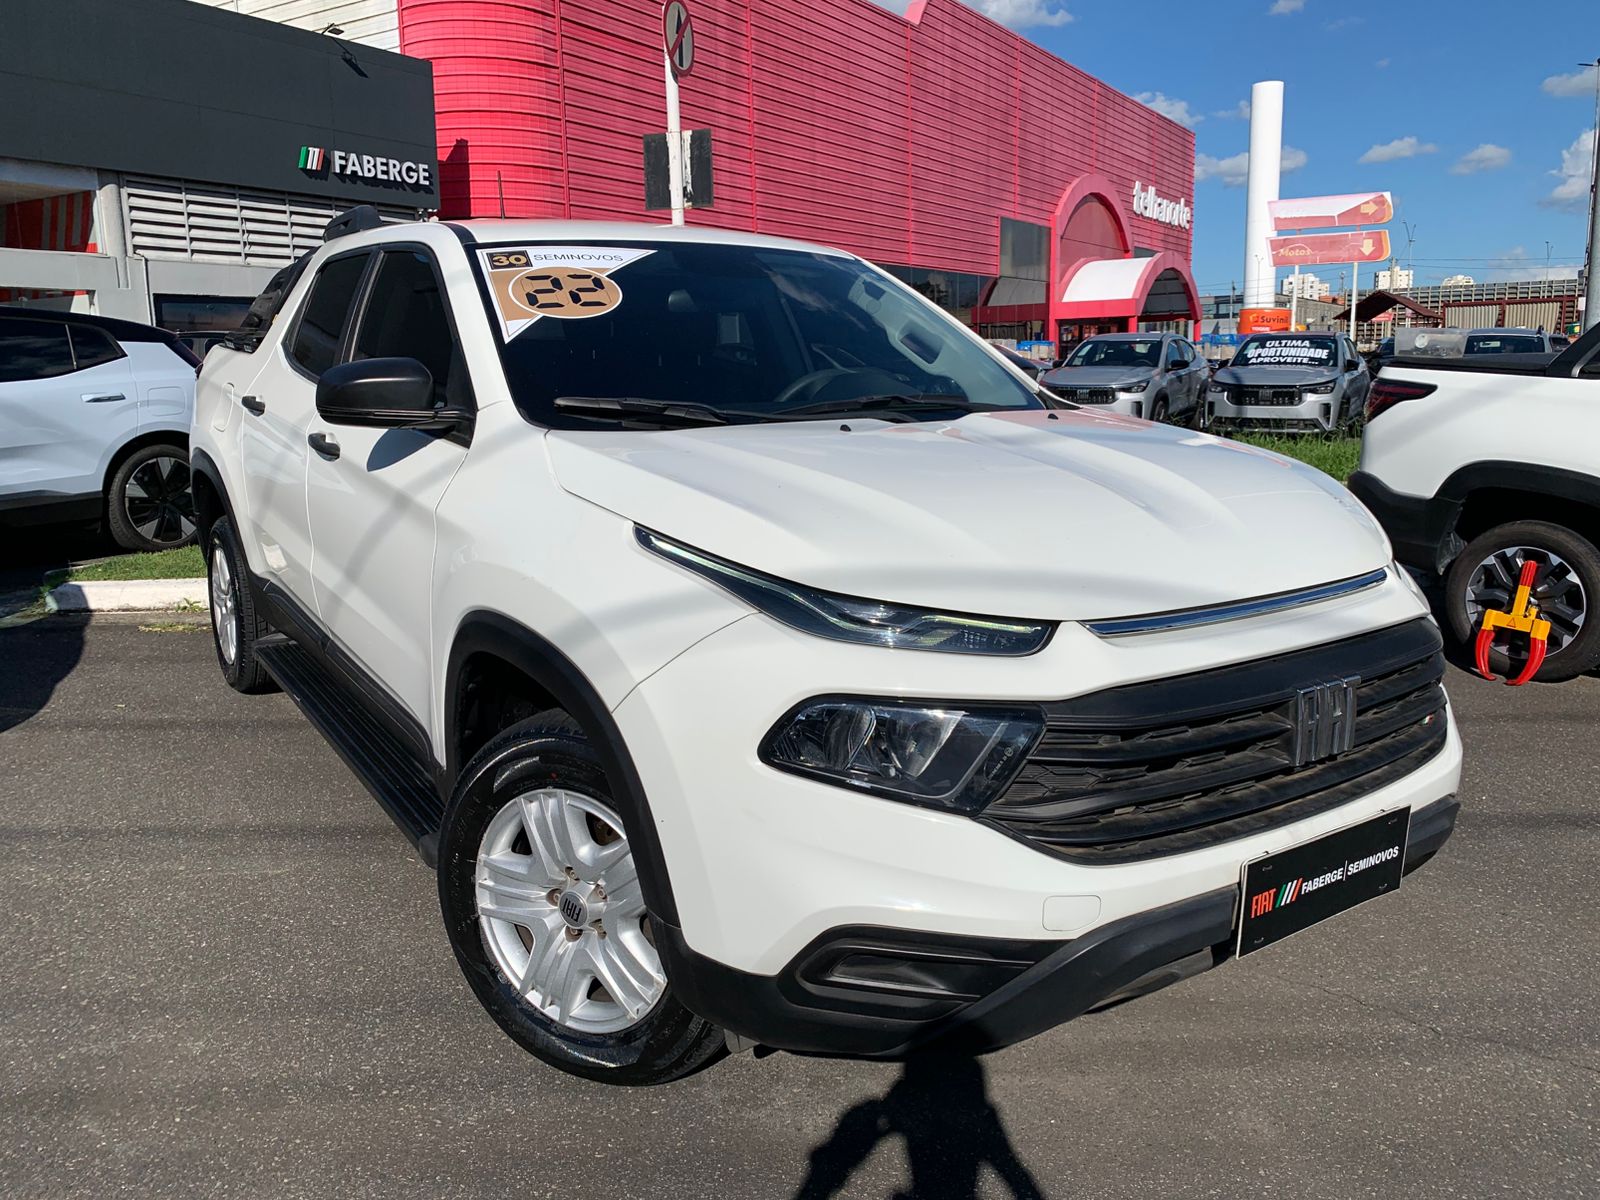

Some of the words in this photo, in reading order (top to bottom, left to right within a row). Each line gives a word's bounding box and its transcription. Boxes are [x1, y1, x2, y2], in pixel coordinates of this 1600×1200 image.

[332, 150, 430, 185] FABERGE
[1133, 181, 1191, 229] telhanorte
[492, 254, 528, 266] 30
[533, 253, 624, 262] SEMINOVOS
[1279, 247, 1311, 257] Motos
[525, 274, 608, 308] 22
[1247, 347, 1330, 359] OPORTUNIDADE
[1295, 676, 1361, 767] FIAT
[1251, 888, 1276, 918] FIAT
[1301, 868, 1344, 895] FABERGE
[1347, 846, 1399, 876] SEMINOVOS
[561, 898, 582, 923] FIAT
